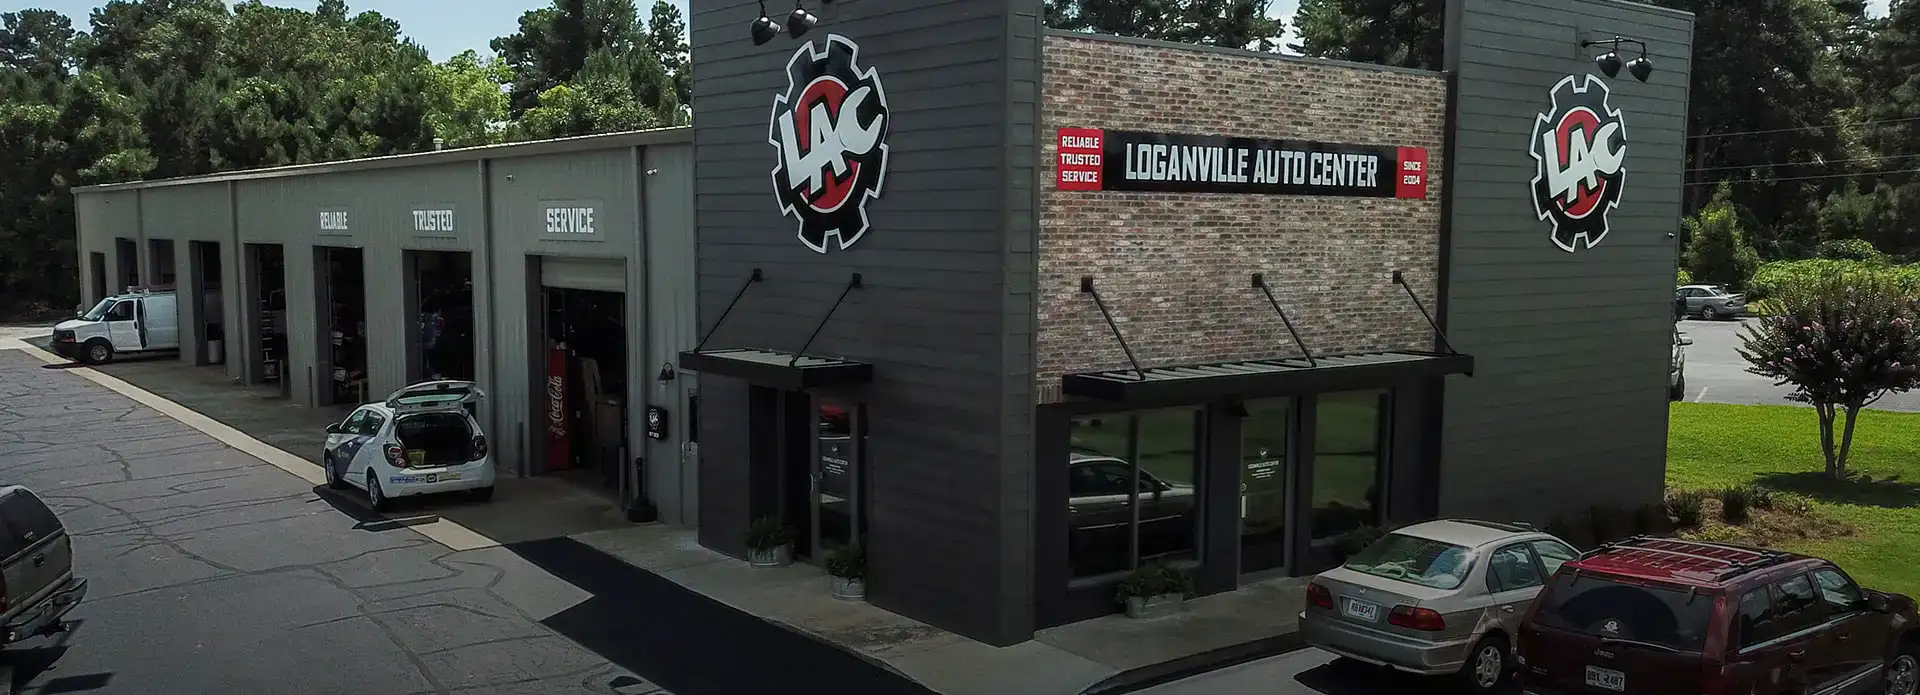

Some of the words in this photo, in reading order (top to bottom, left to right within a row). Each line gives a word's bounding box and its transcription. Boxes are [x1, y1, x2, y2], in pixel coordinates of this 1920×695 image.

[779, 86, 883, 195] LAC
[1062, 136, 1099, 149] RELIABLE
[1061, 153, 1100, 166] TRUSTED
[1125, 143, 1249, 183] LOGANVILLE
[1253, 149, 1306, 184] AUTO
[1310, 152, 1378, 187] CENTER
[1403, 161, 1421, 171] SINCE
[1543, 122, 1626, 204] LAC
[1062, 171, 1098, 183] SERVICE
[1403, 175, 1420, 185] 2004
[320, 211, 348, 230] RELIABLE
[413, 209, 453, 231] TRUSTED
[546, 207, 594, 233] SERVICE
